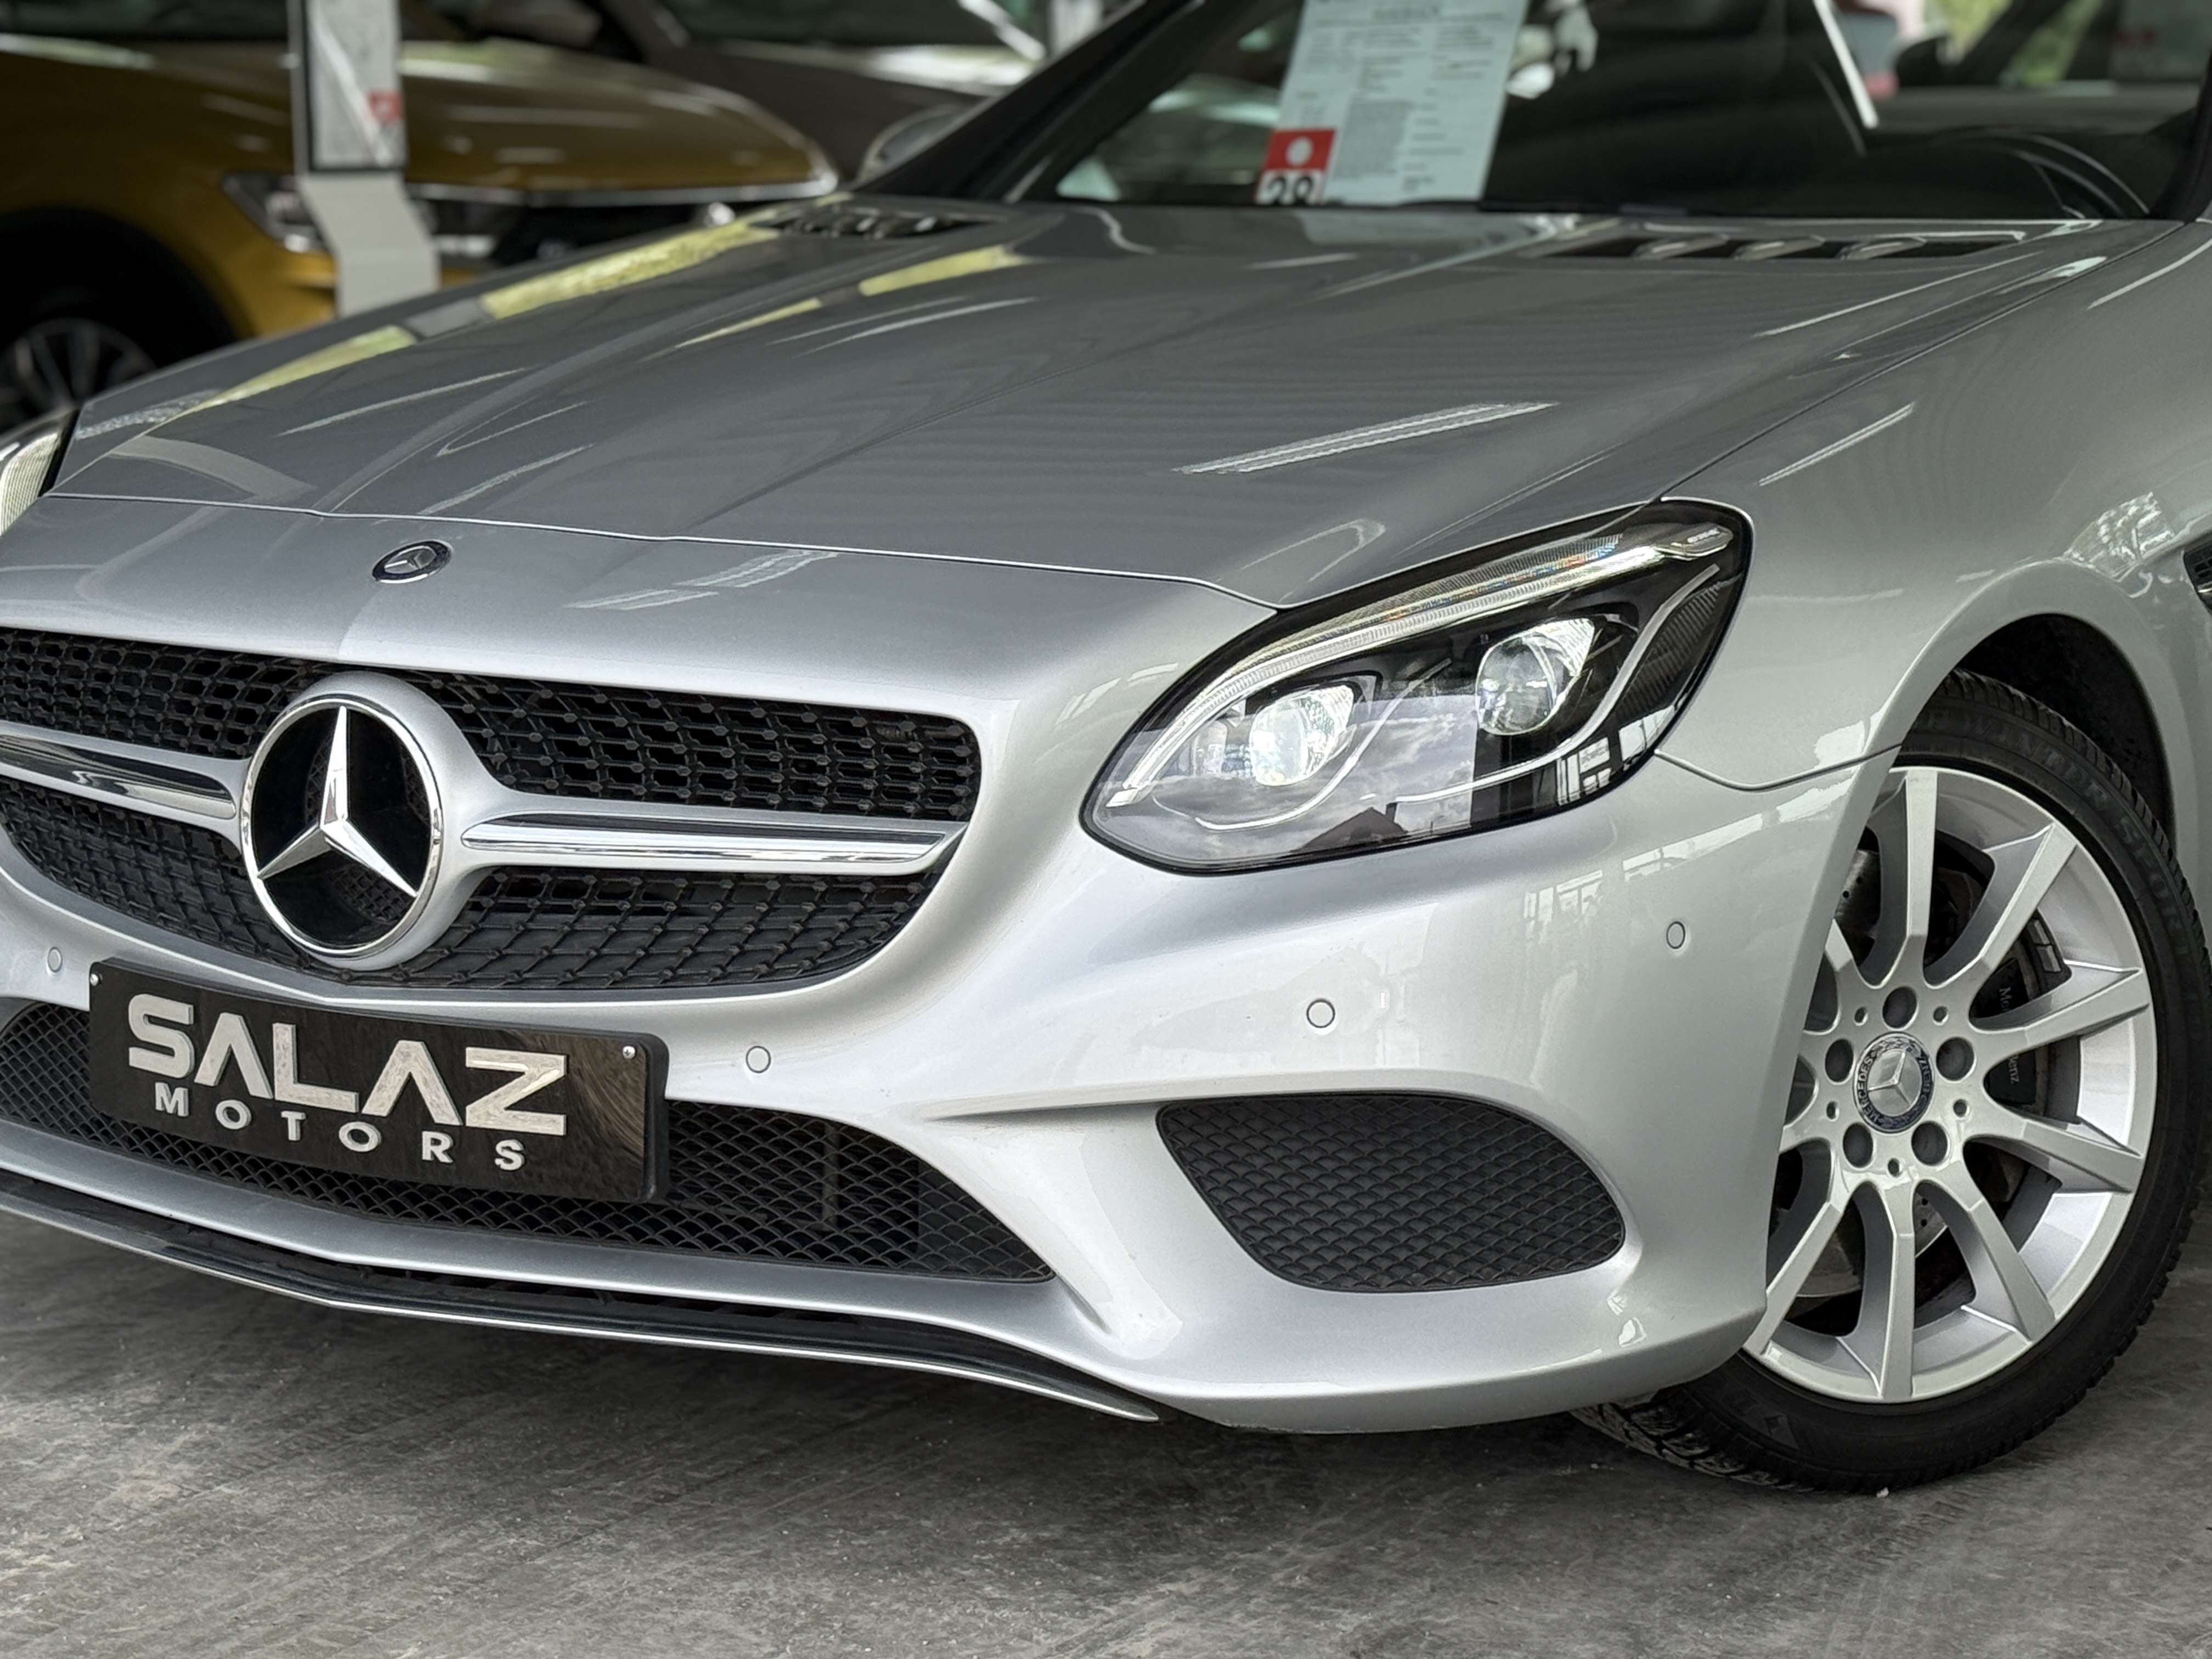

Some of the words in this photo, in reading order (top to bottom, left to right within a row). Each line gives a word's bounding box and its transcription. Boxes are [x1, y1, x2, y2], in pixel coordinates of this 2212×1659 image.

[128, 993, 567, 1136] SALAZ
[1858, 1057, 1881, 1123] MERCEDES
[1918, 1057, 1931, 1093] BENZ
[154, 1082, 525, 1171] MOTORS
